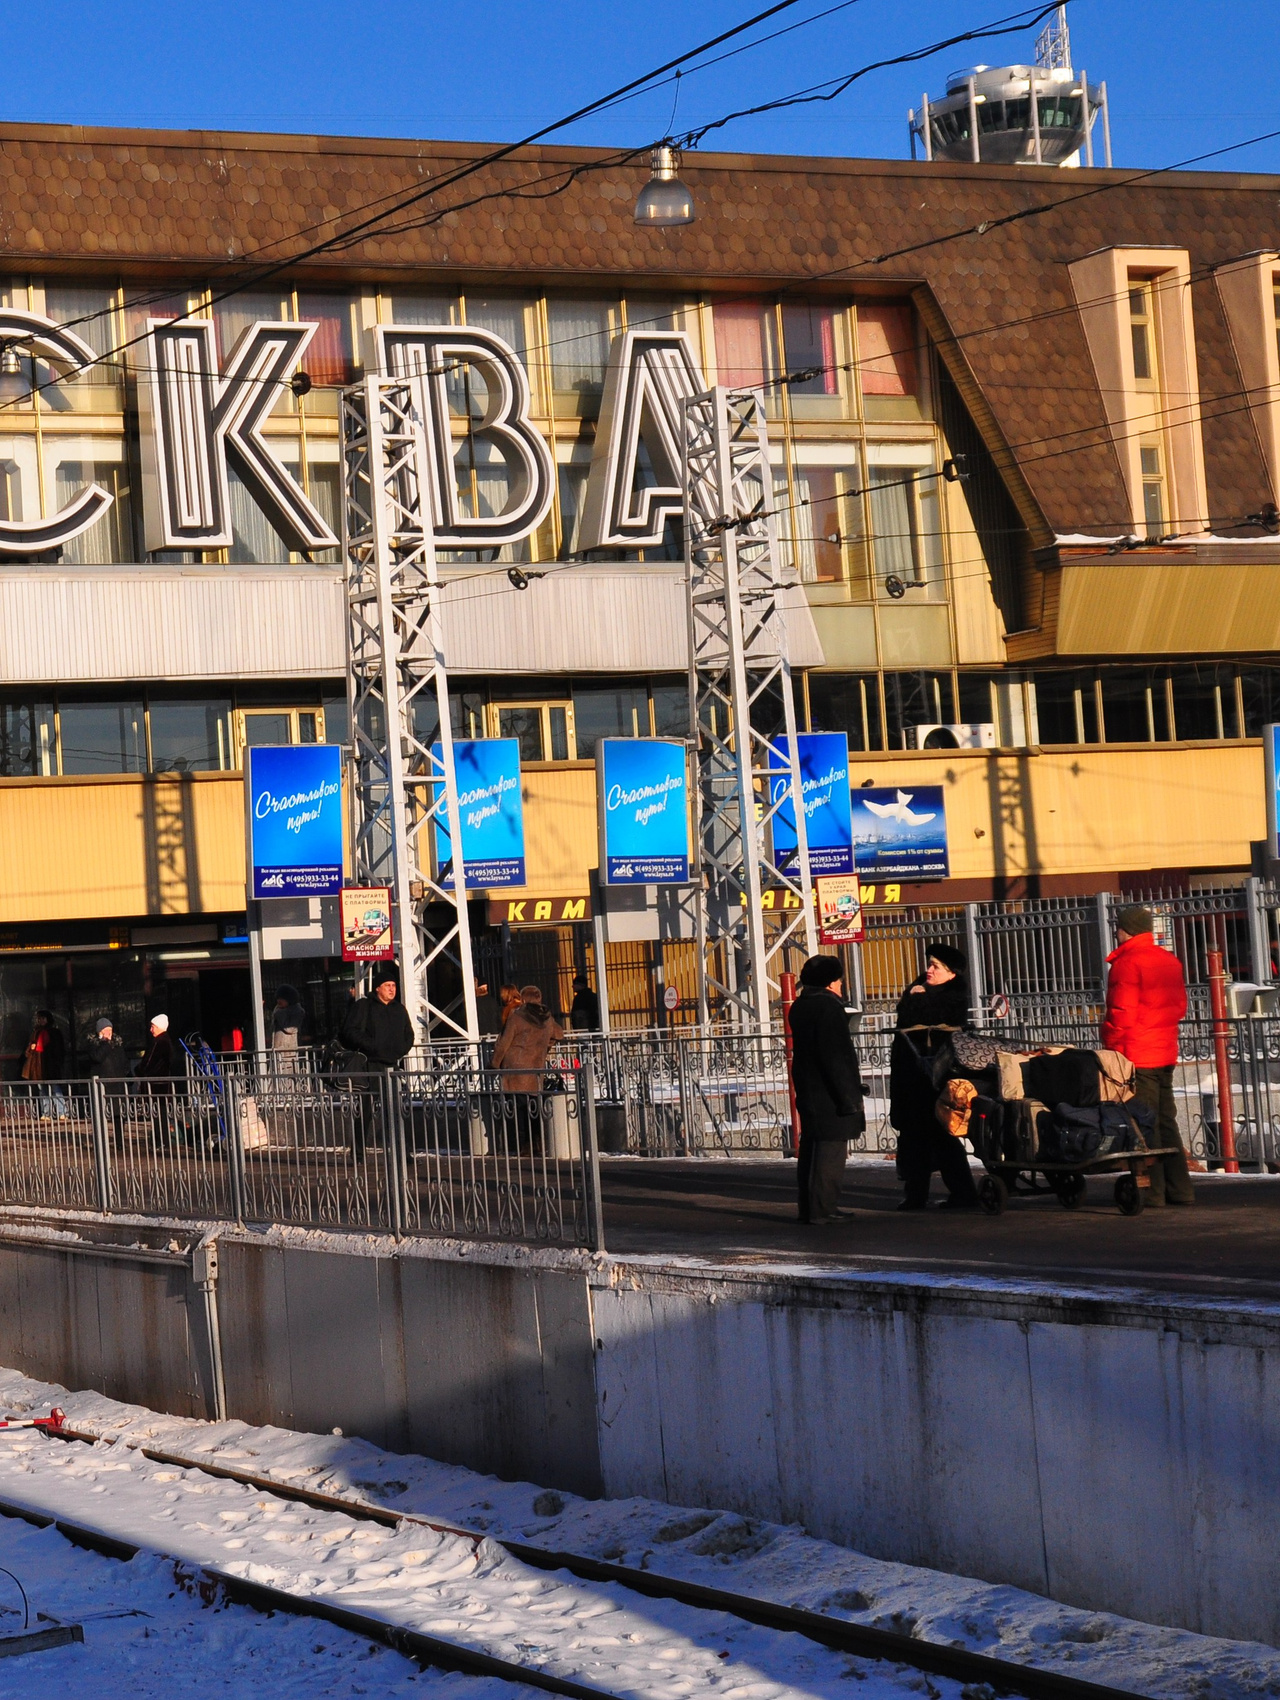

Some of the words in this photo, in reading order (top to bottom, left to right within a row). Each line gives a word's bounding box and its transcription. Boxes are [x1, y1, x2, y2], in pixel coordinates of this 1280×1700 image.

[256, 780, 338, 819] Счастливого
[437, 775, 517, 815] Састливого
[607, 774, 683, 811] Счастливого
[635, 792, 668, 826] пути!
[287, 800, 322, 834] пути!
[467, 794, 501, 829] пути!
[286, 874, 339, 884] 8(495)933-33-44
[468, 867, 519, 877] 8(495)933-33-44
[635, 865, 683, 873] 8(495)933-33-44
[876, 864, 919, 873] АЗЕРБАЙДЖАНА
[507, 899, 586, 922] КАМ
